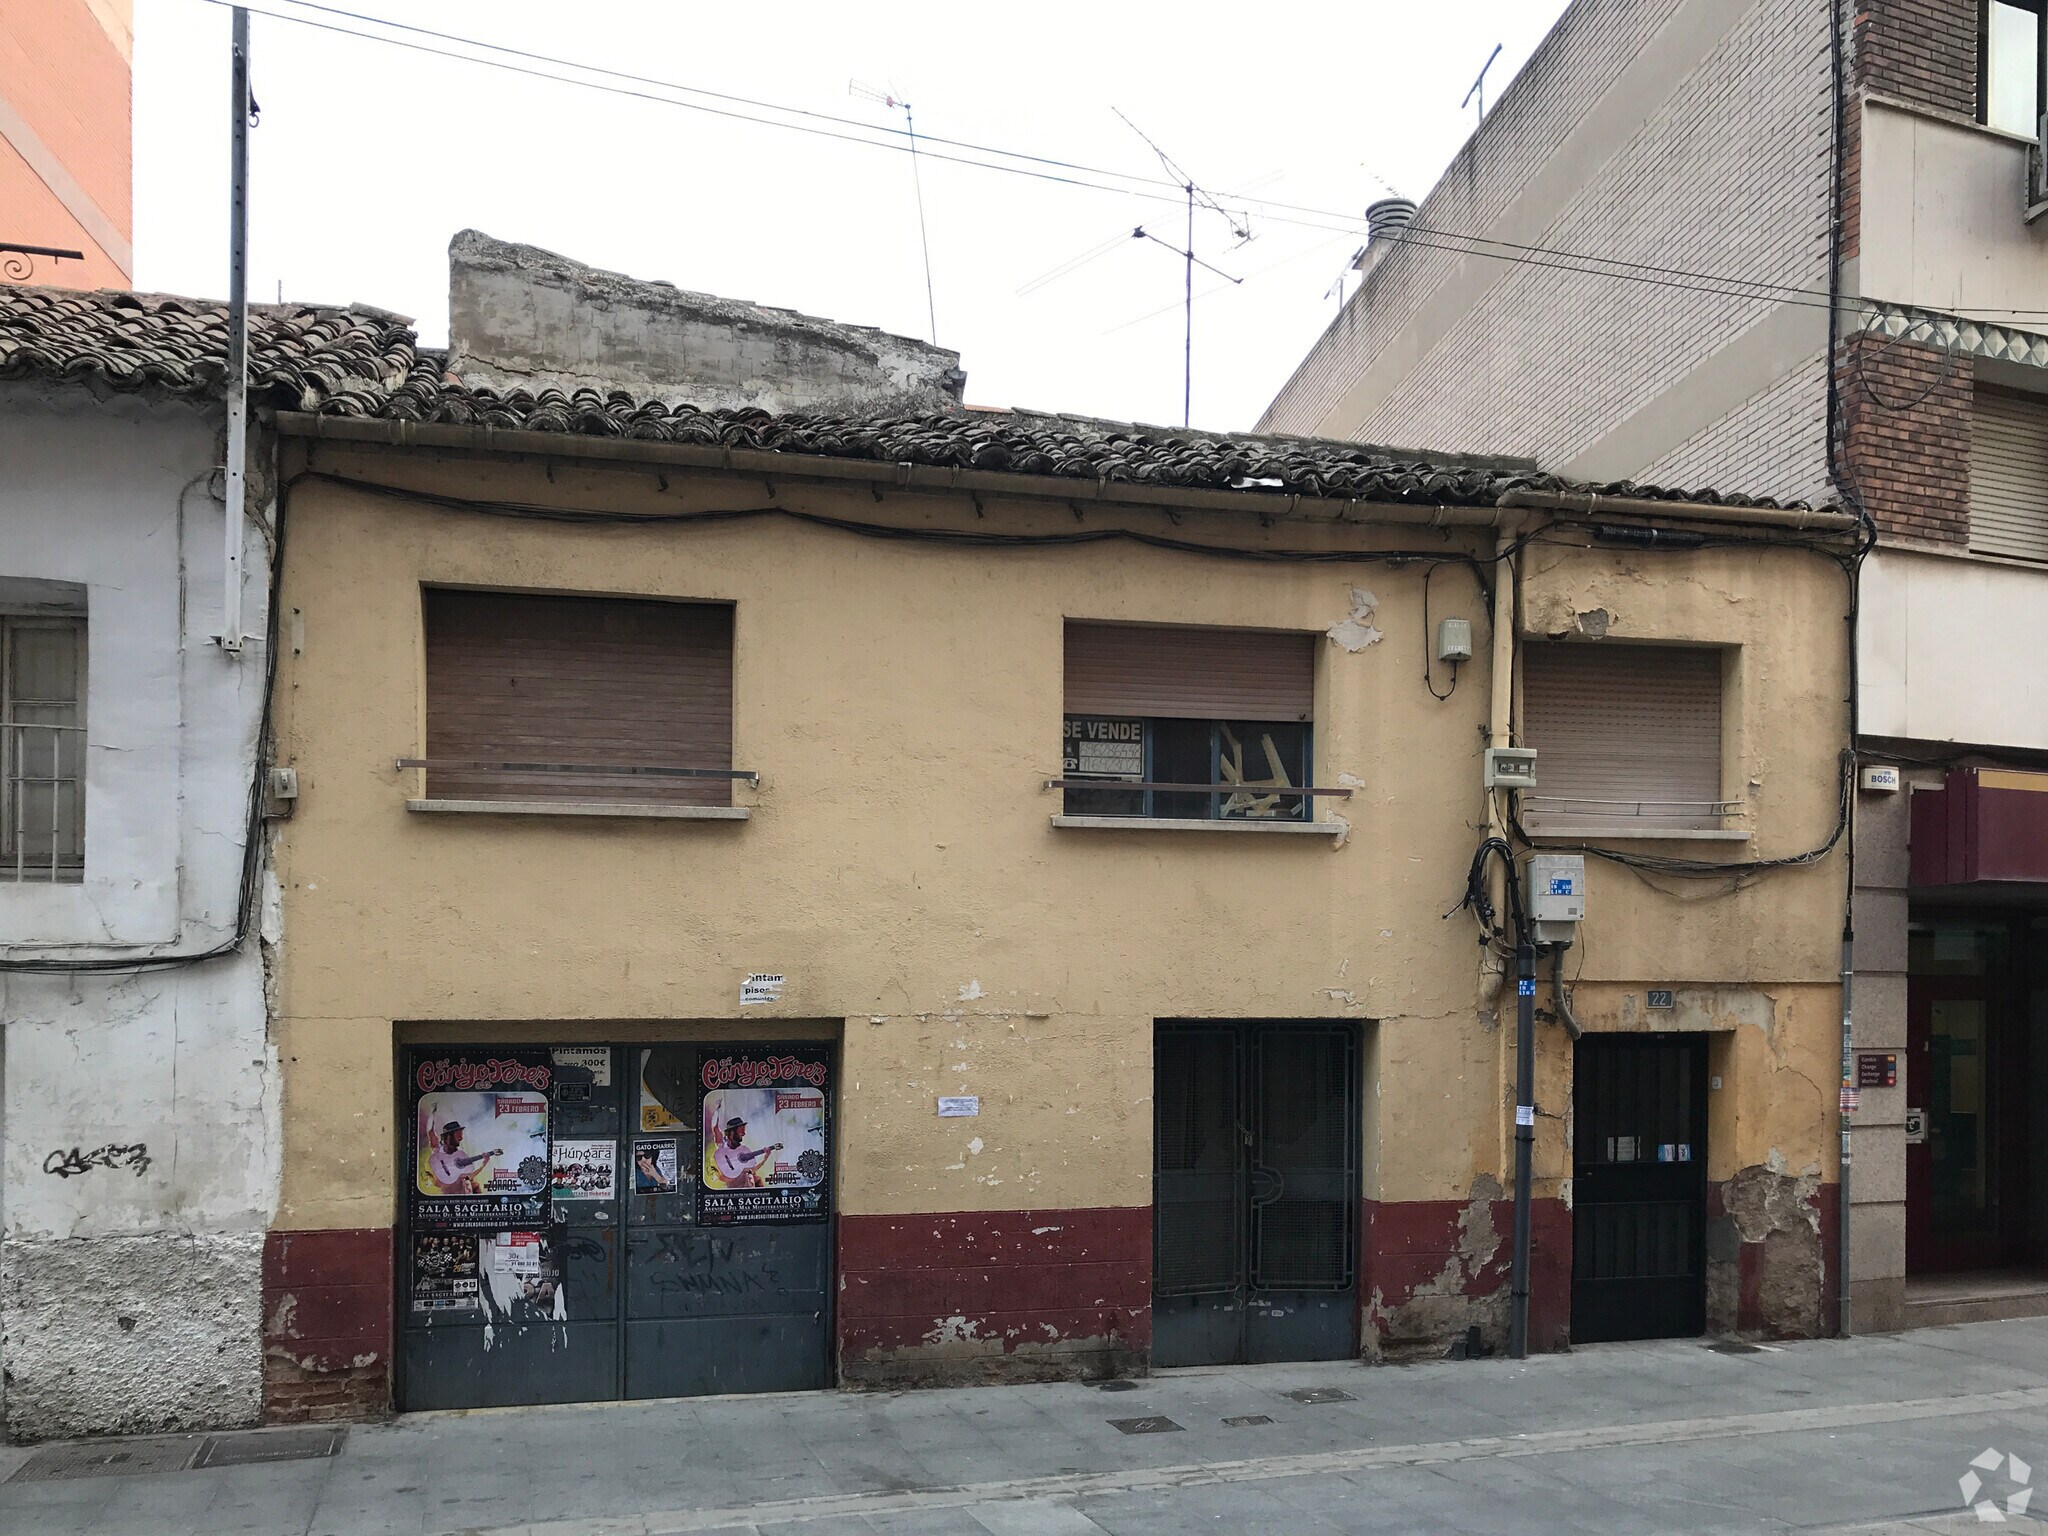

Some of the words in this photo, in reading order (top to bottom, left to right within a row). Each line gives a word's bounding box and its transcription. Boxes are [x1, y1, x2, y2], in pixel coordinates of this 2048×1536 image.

[1064, 721, 1081, 738] SE
[1087, 722, 1140, 740] VENDE
[1872, 775, 1896, 784] BOSCH
[1652, 992, 1666, 1006] 22
[779, 1100, 789, 1108] 23
[558, 1147, 612, 1163] Húngara
[738, 1196, 802, 1204] SAGITARIO
[454, 1203, 522, 1212] SAGITARIO
